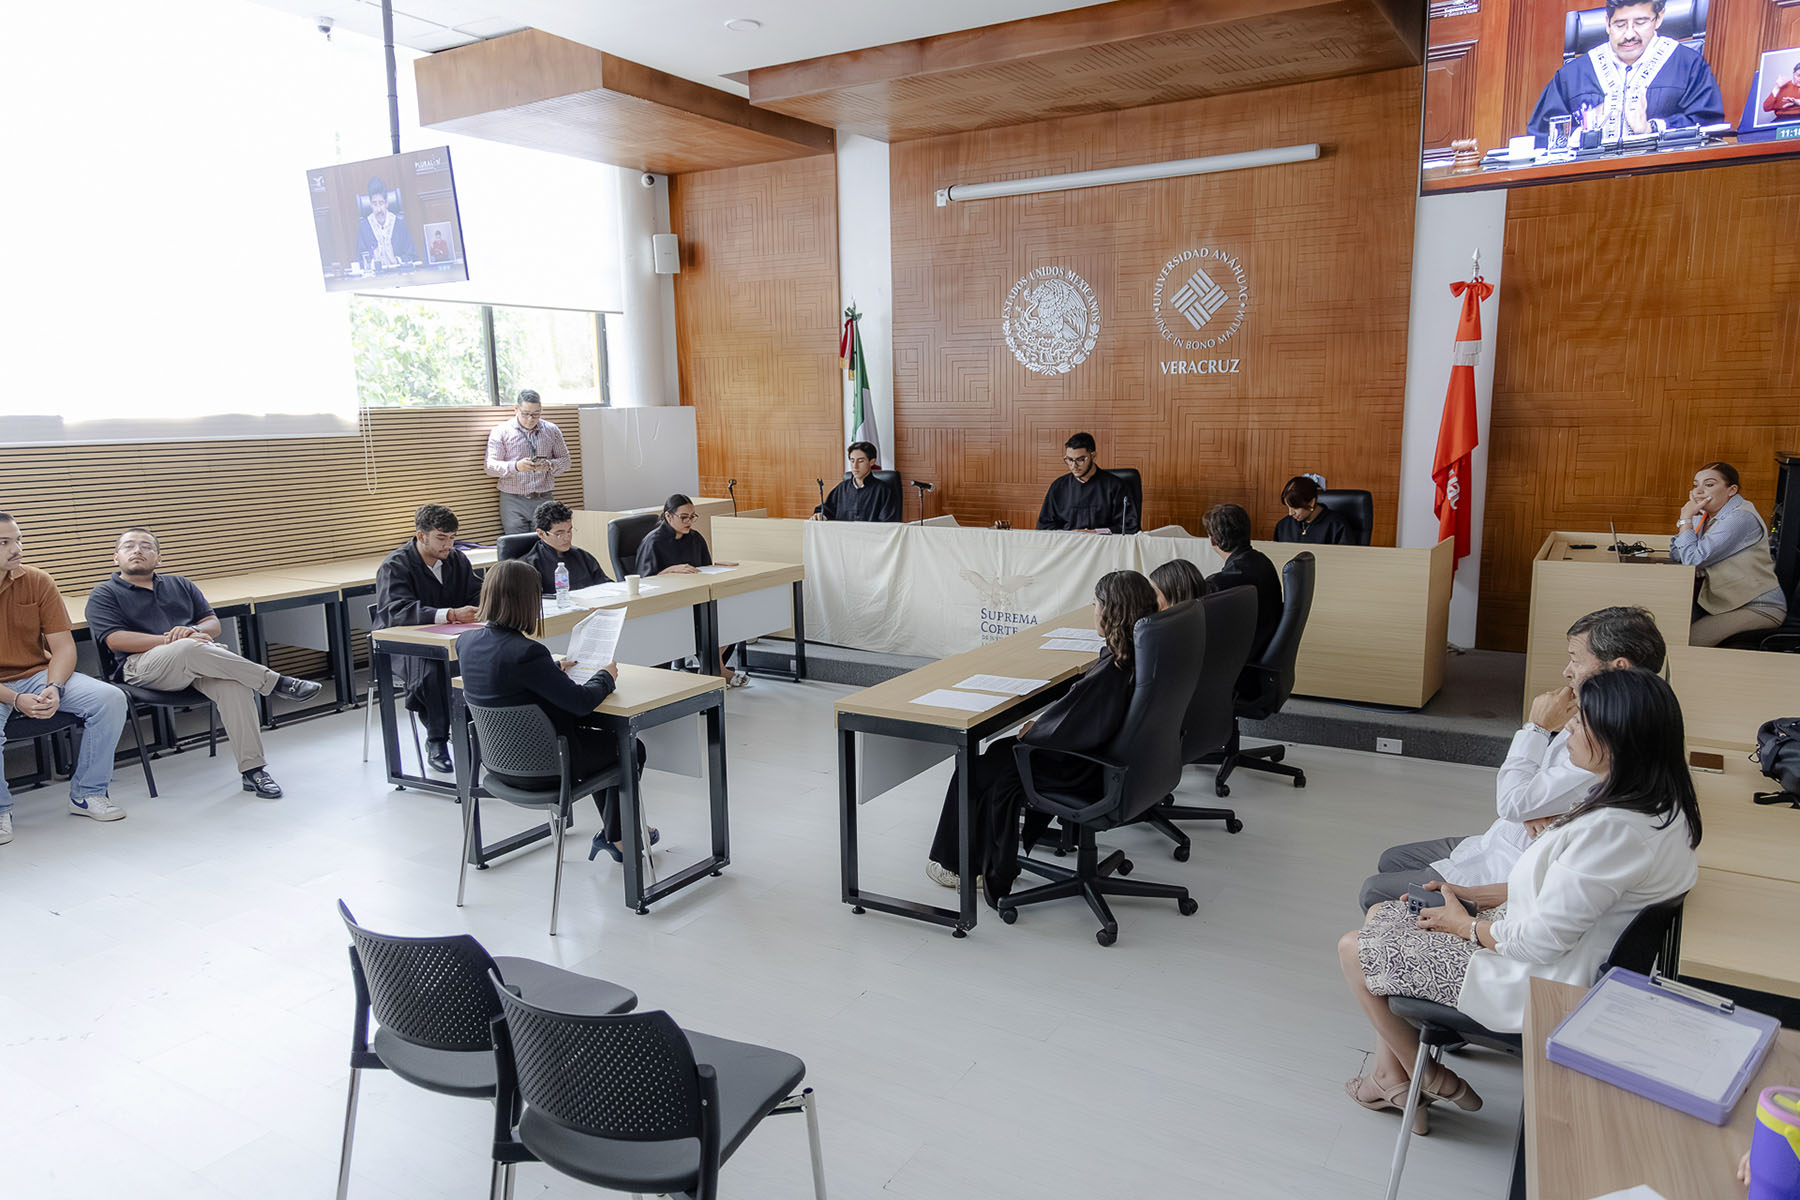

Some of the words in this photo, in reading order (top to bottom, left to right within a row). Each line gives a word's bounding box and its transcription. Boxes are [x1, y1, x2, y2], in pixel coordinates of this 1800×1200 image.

[1002, 276, 1028, 319] ESTADOS
[1029, 265, 1065, 281] UNIDOS
[1066, 269, 1101, 322] MEXICANOS
[1152, 247, 1209, 306] UNIVERSIDAD
[1211, 248, 1249, 302] ANÁHUAC
[1154, 313, 1174, 342] VINCE
[1173, 336, 1185, 349] IN
[1185, 338, 1216, 350] BONO
[1217, 309, 1246, 345] MALUM
[1160, 358, 1241, 375] VERACRUZ
[980, 607, 1038, 625] SUPREMA
